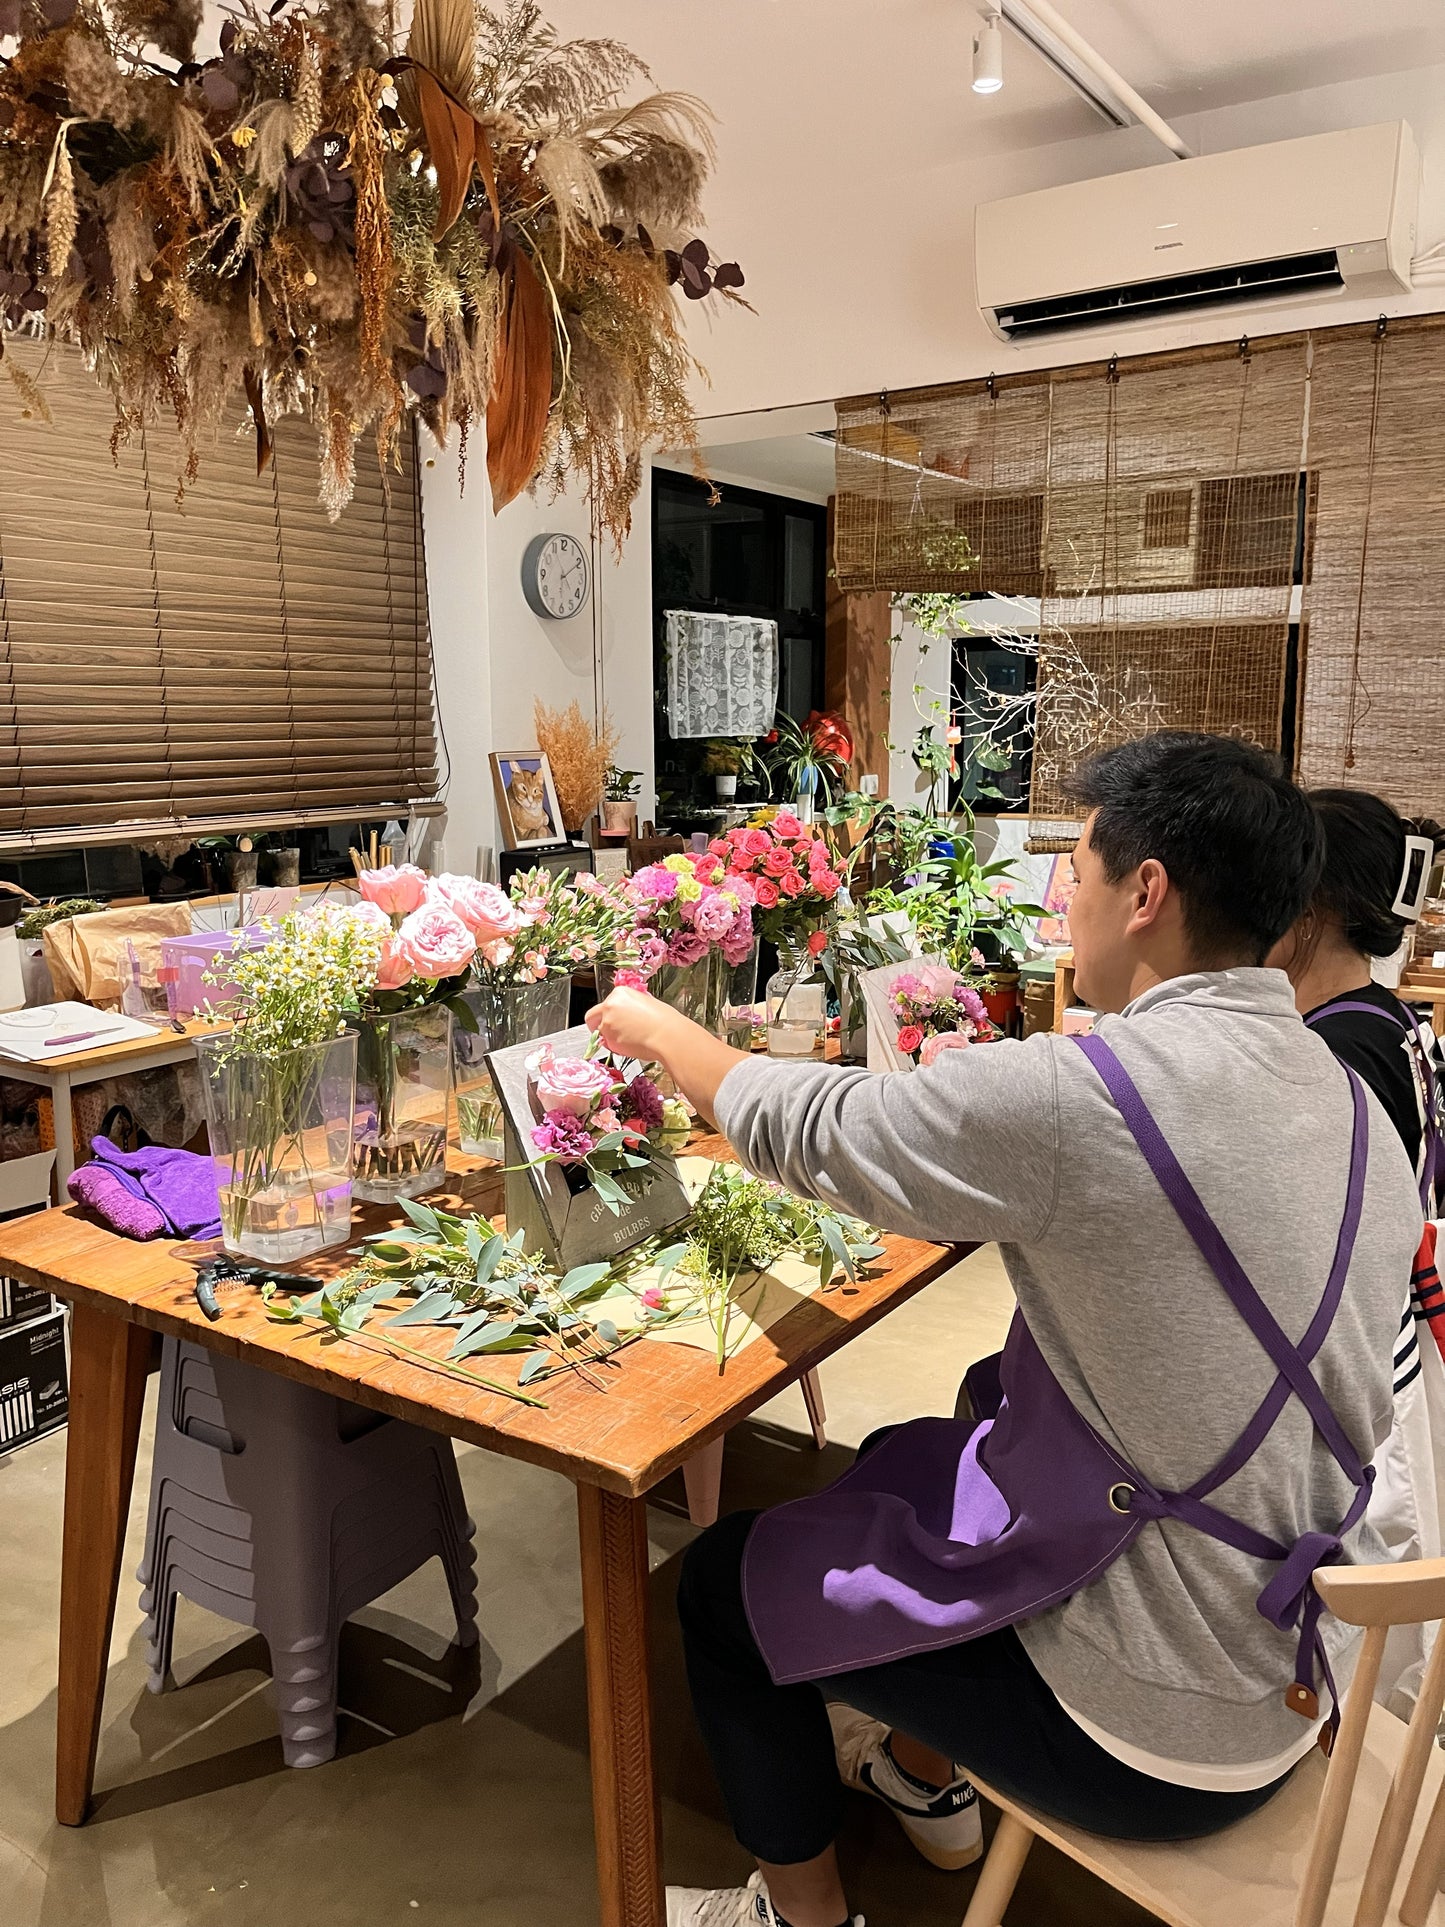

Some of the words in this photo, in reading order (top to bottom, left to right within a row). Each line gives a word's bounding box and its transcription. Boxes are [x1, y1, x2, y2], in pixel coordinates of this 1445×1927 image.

[552, 542, 558, 554] 11
[560, 539, 568, 552] 12
[576, 557, 582, 570] 2
[540, 568, 547, 580] 9
[542, 584, 549, 597] 8
[574, 587, 581, 599] 4
[558, 602, 564, 614] 6
[568, 599, 574, 611] 5
[620, 1204, 632, 1217] de
[613, 1216, 651, 1244] BULBES
[30, 1327, 59, 1345] Midnight
[951, 1784, 975, 1806] NIKE
[758, 1897, 769, 1921] NIKE
